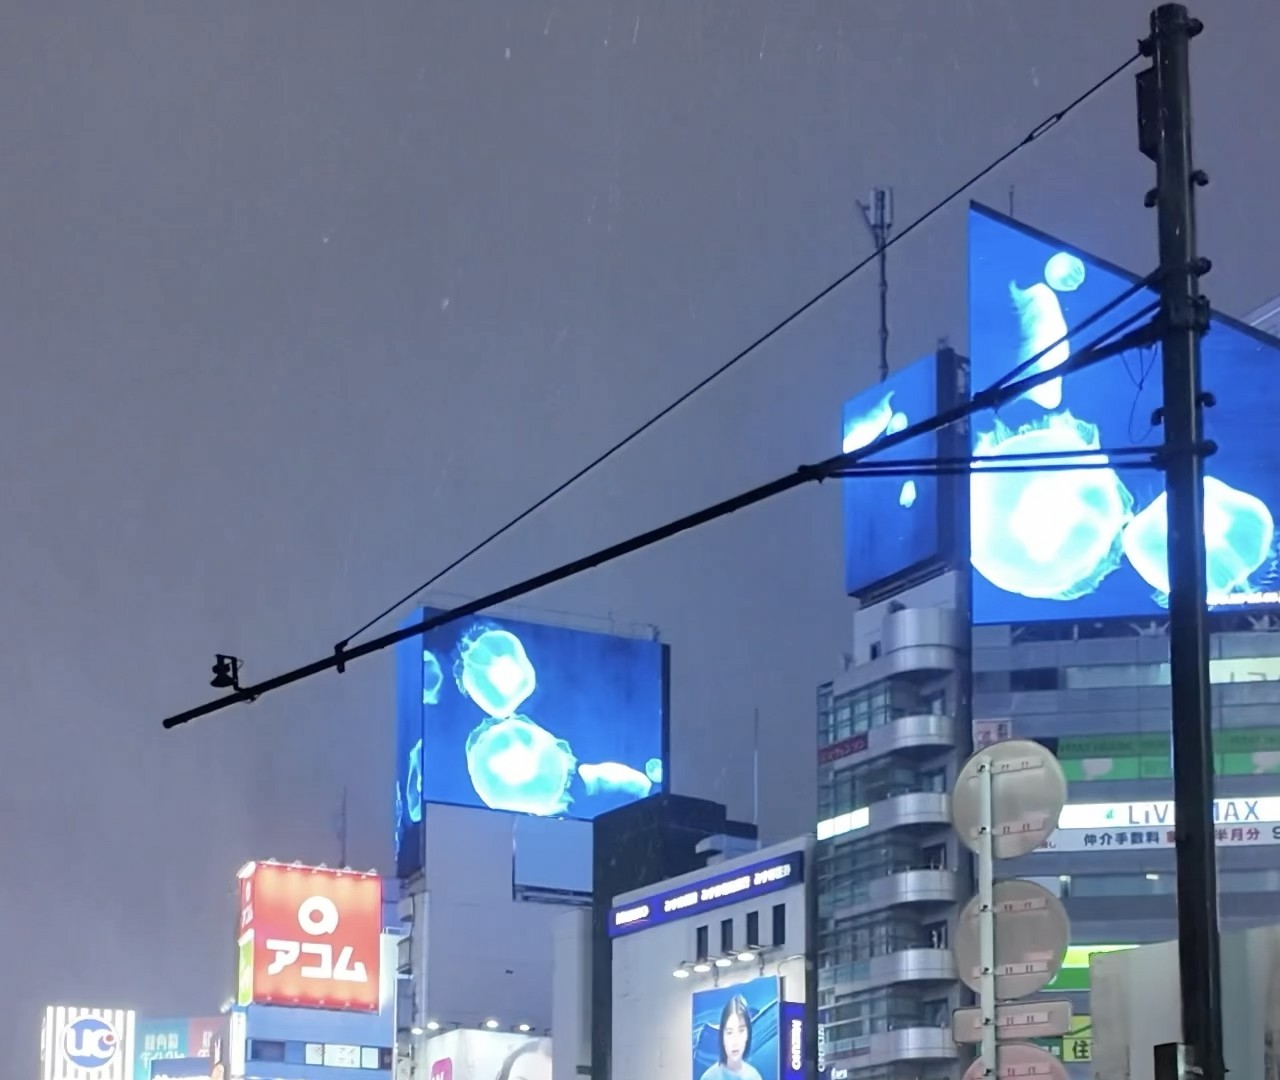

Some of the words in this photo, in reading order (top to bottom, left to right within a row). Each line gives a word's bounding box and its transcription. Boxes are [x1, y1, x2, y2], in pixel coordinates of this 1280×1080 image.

[266, 939, 368, 982] アコム
[1071, 1040, 1091, 1059] 住
